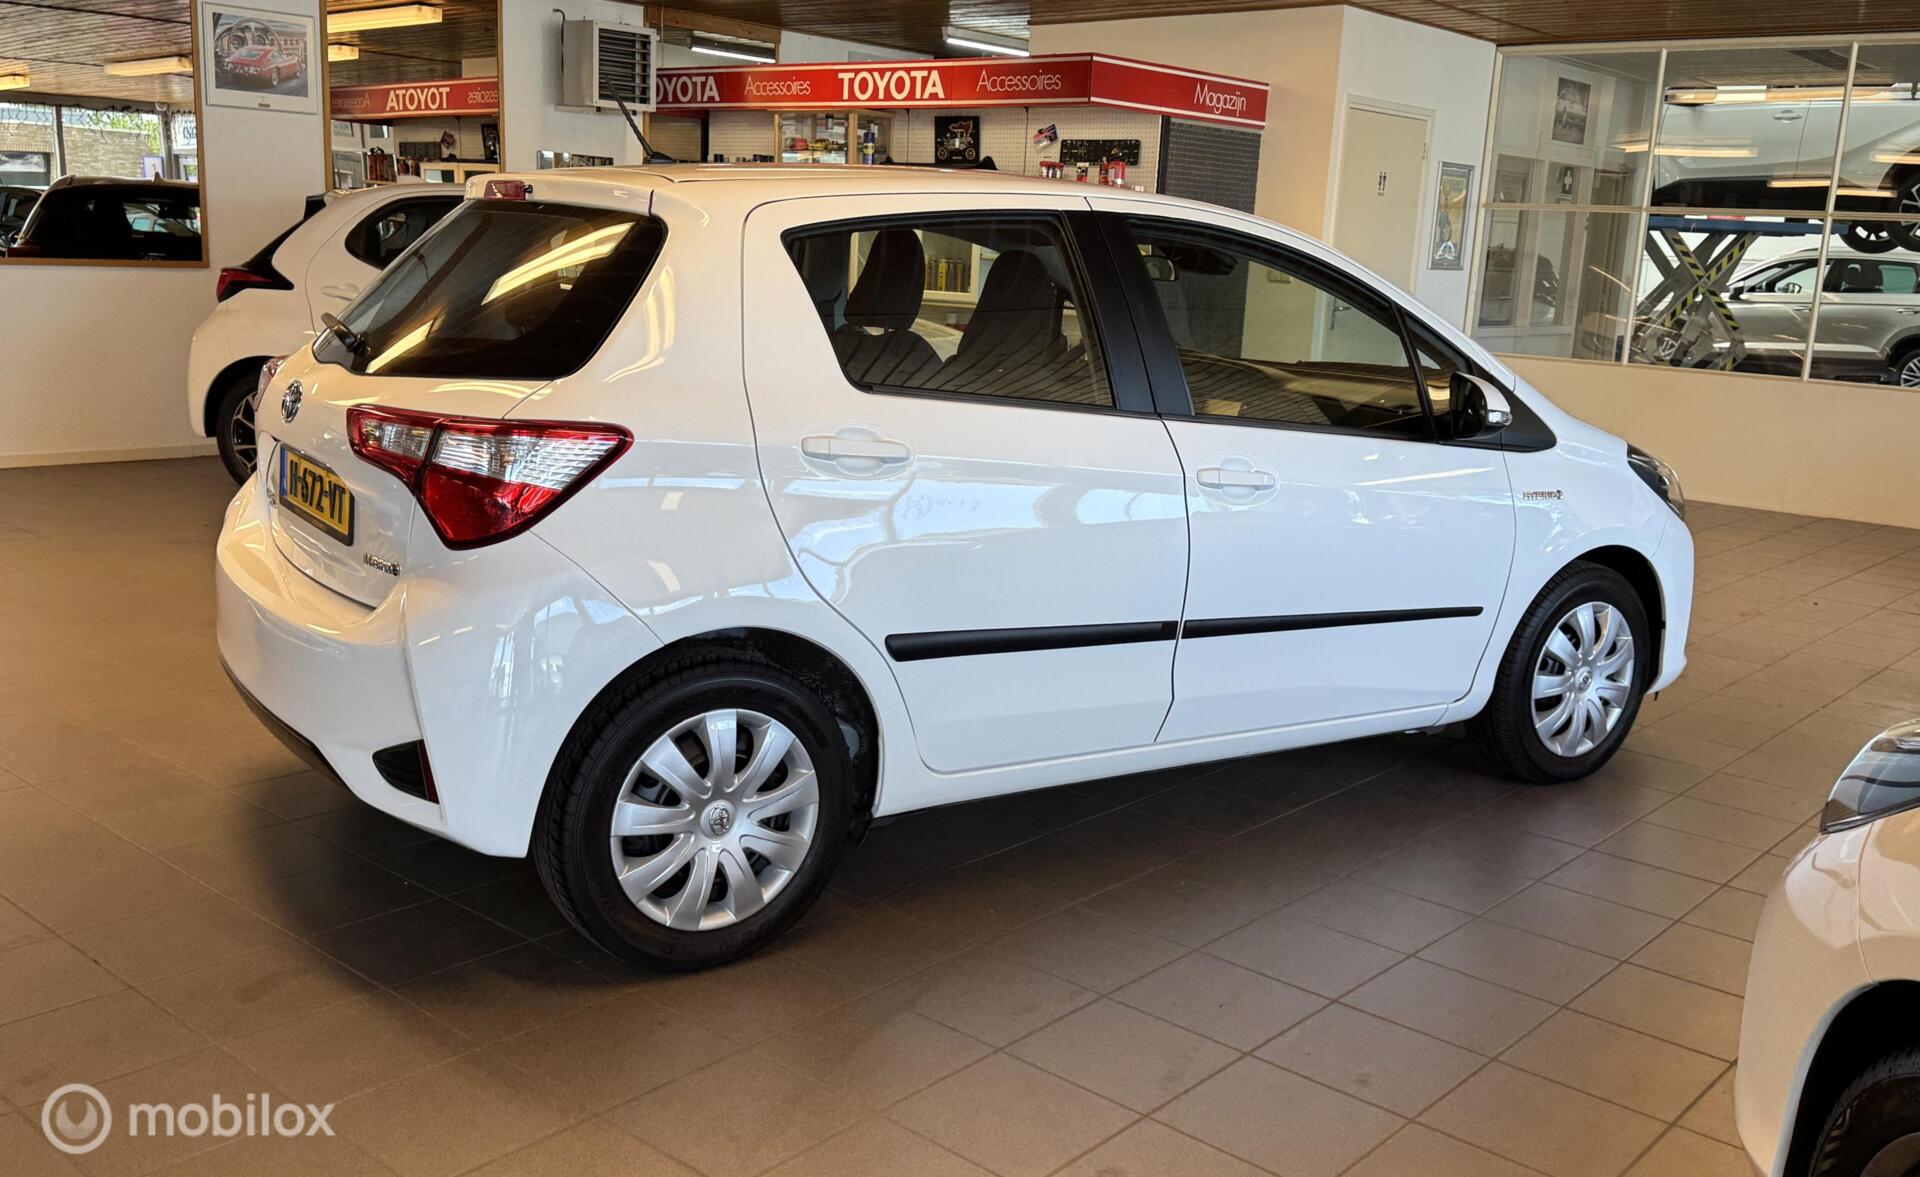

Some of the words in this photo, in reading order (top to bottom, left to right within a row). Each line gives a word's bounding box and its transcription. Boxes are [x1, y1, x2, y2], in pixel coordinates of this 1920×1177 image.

[744, 75, 811, 96] Accessoires
[838, 70, 945, 101] TOYOTA
[976, 68, 1062, 93] Accessoires
[1194, 83, 1247, 117] Magazijn
[289, 459, 346, 525] H-672-VT
